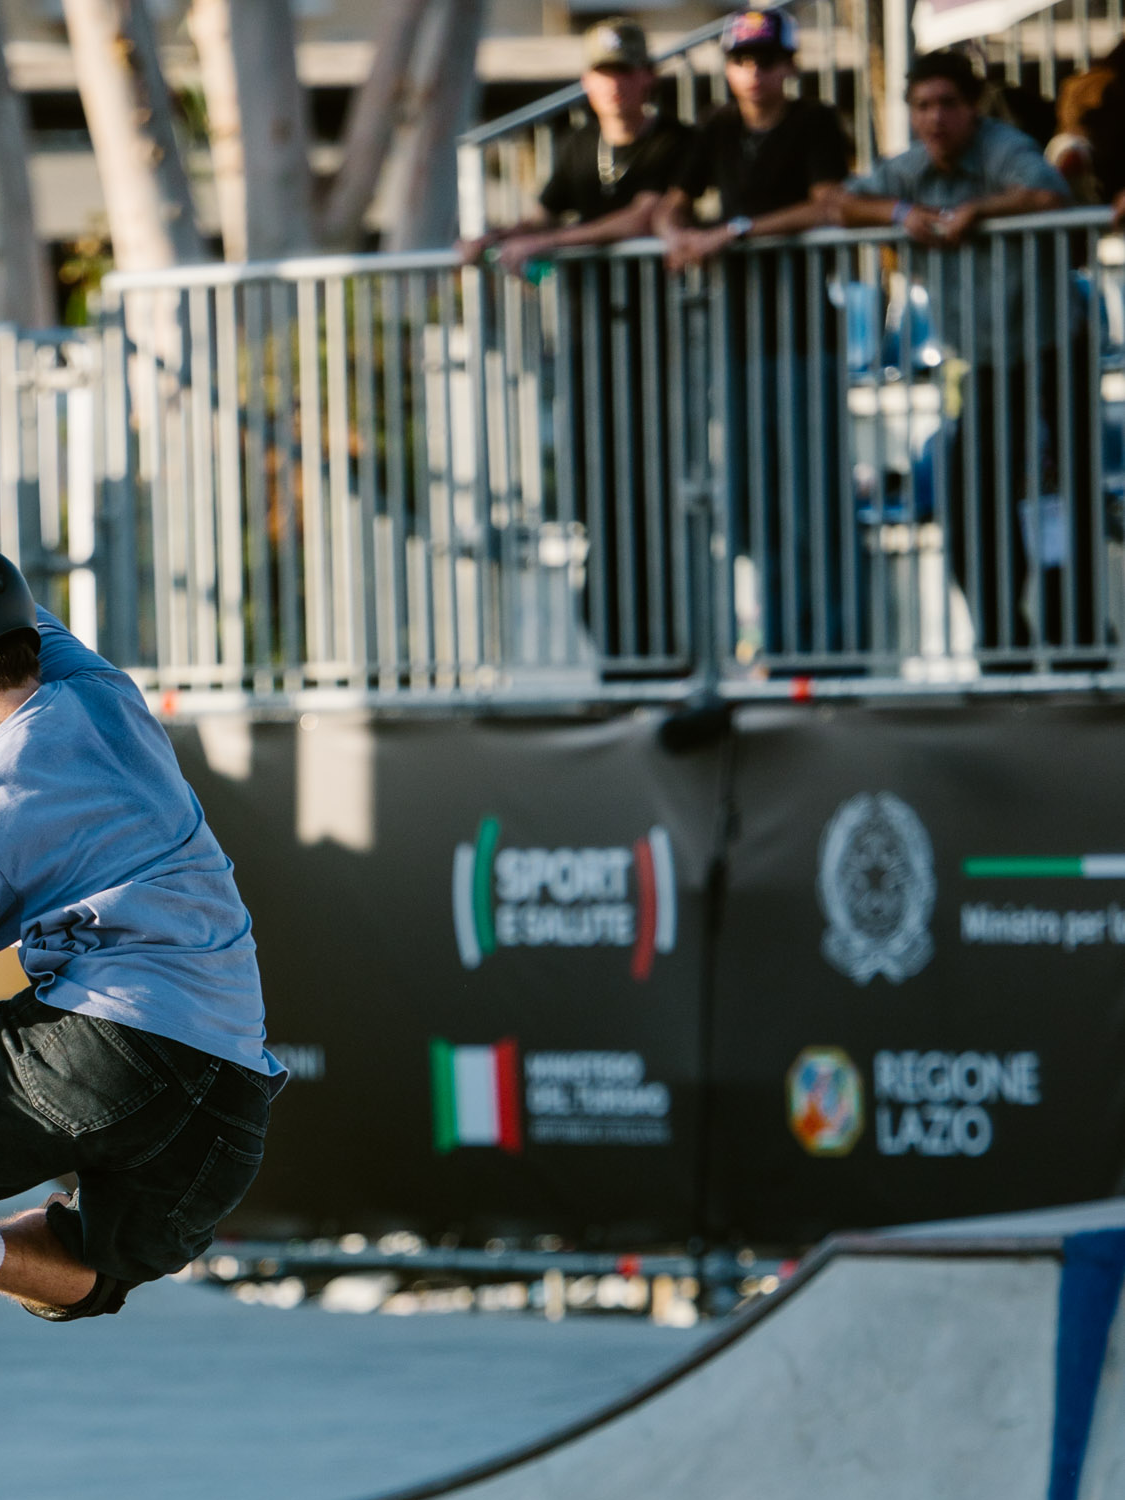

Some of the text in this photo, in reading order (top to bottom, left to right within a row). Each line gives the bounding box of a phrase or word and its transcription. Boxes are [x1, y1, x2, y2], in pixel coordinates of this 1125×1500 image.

[496, 848, 632, 901] SPORT
[523, 903, 635, 947] SALUTE
[874, 1050, 1041, 1104] REGIONE
